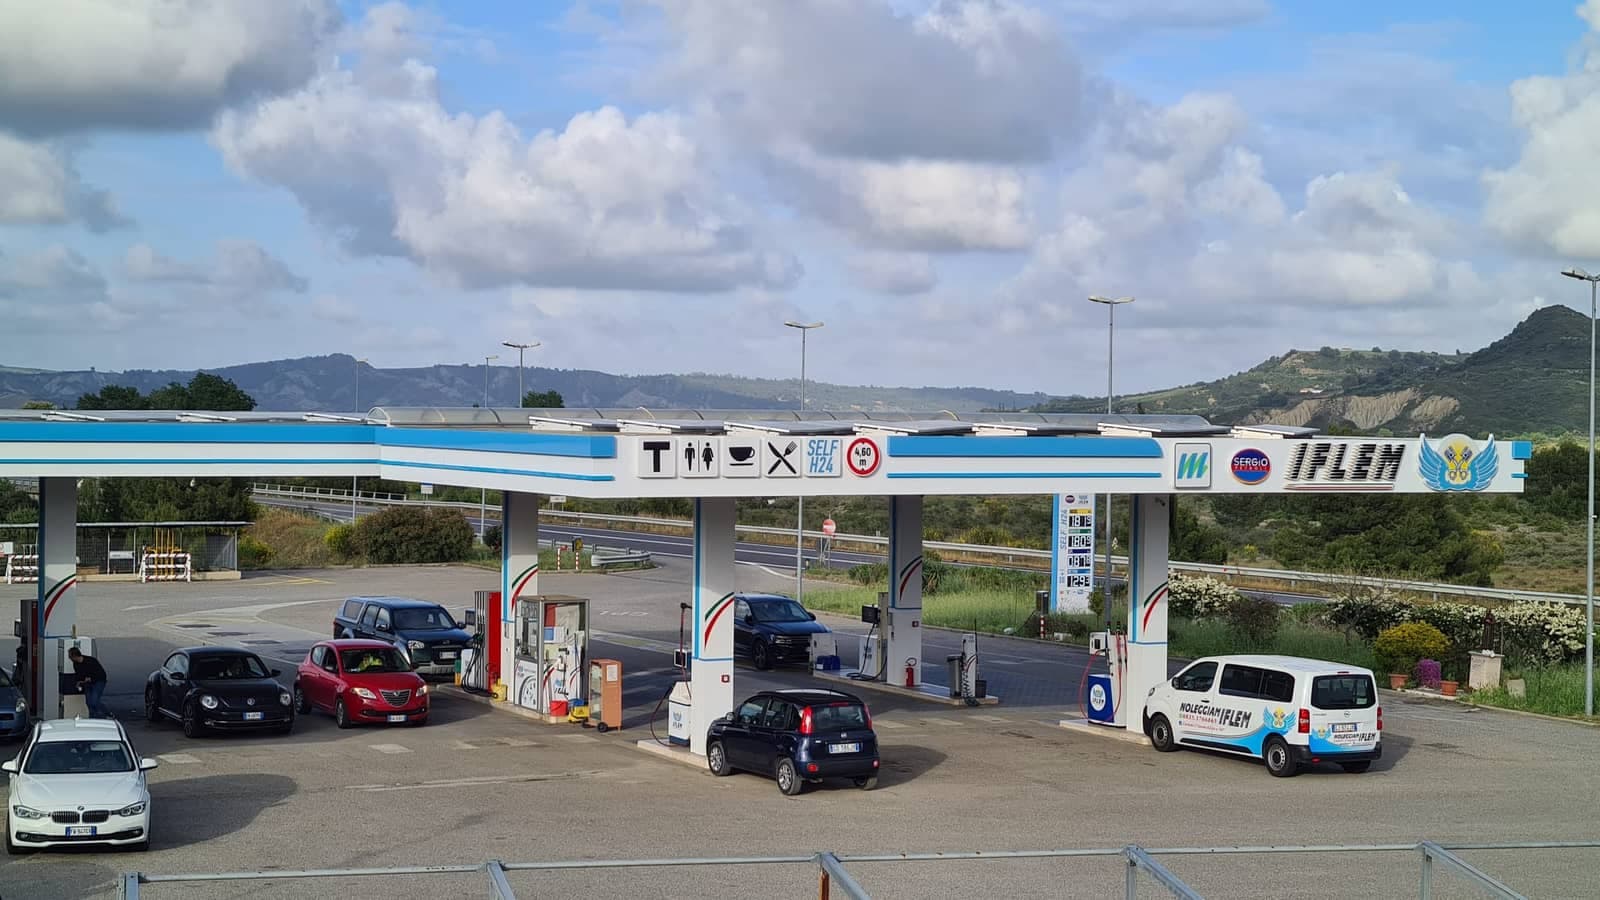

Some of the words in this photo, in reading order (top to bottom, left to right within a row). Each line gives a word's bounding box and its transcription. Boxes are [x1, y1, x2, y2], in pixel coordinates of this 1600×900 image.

[808, 439, 839, 457] SELF
[854, 447, 872, 457] 4,60
[643, 441, 670, 473] T
[809, 456, 833, 473] H24
[859, 458, 867, 466] m
[1287, 443, 1406, 480] IFLEM
[1180, 702, 1220, 718] NOLEGGIAM
[1218, 708, 1252, 728] IFLEM
